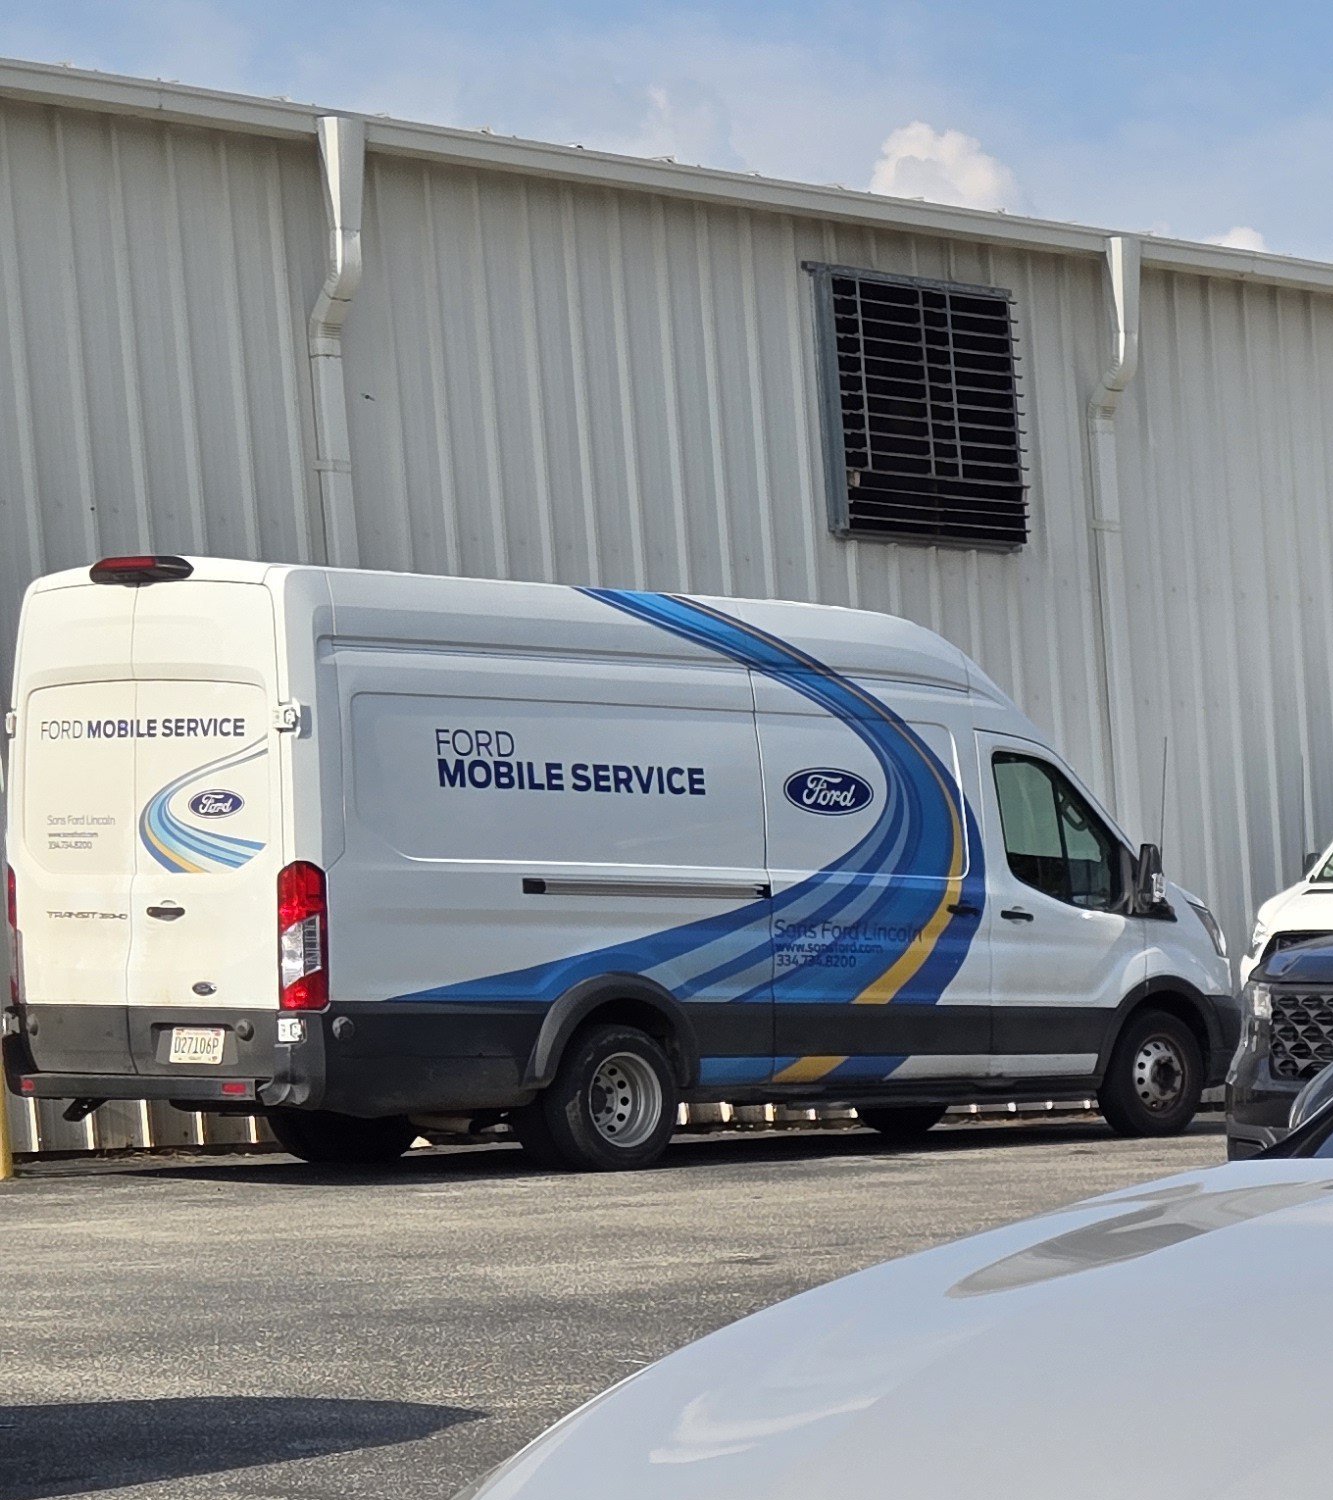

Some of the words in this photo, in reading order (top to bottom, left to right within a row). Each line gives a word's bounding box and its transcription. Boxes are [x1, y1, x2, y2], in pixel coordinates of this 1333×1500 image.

[41, 720, 83, 740] FORD
[87, 719, 157, 739] MOBILE
[161, 718, 245, 738] SERVICE
[435, 729, 515, 758] FORD
[437, 759, 565, 792] MOBILE
[571, 764, 706, 795] SERVICE
[67, 814, 85, 825] Ford
[86, 814, 116, 826] Lincoln
[774, 919, 817, 939] Sons
[821, 920, 859, 940] Ford
[863, 922, 923, 943] Lincoln
[174, 1036, 219, 1054] D27106P
